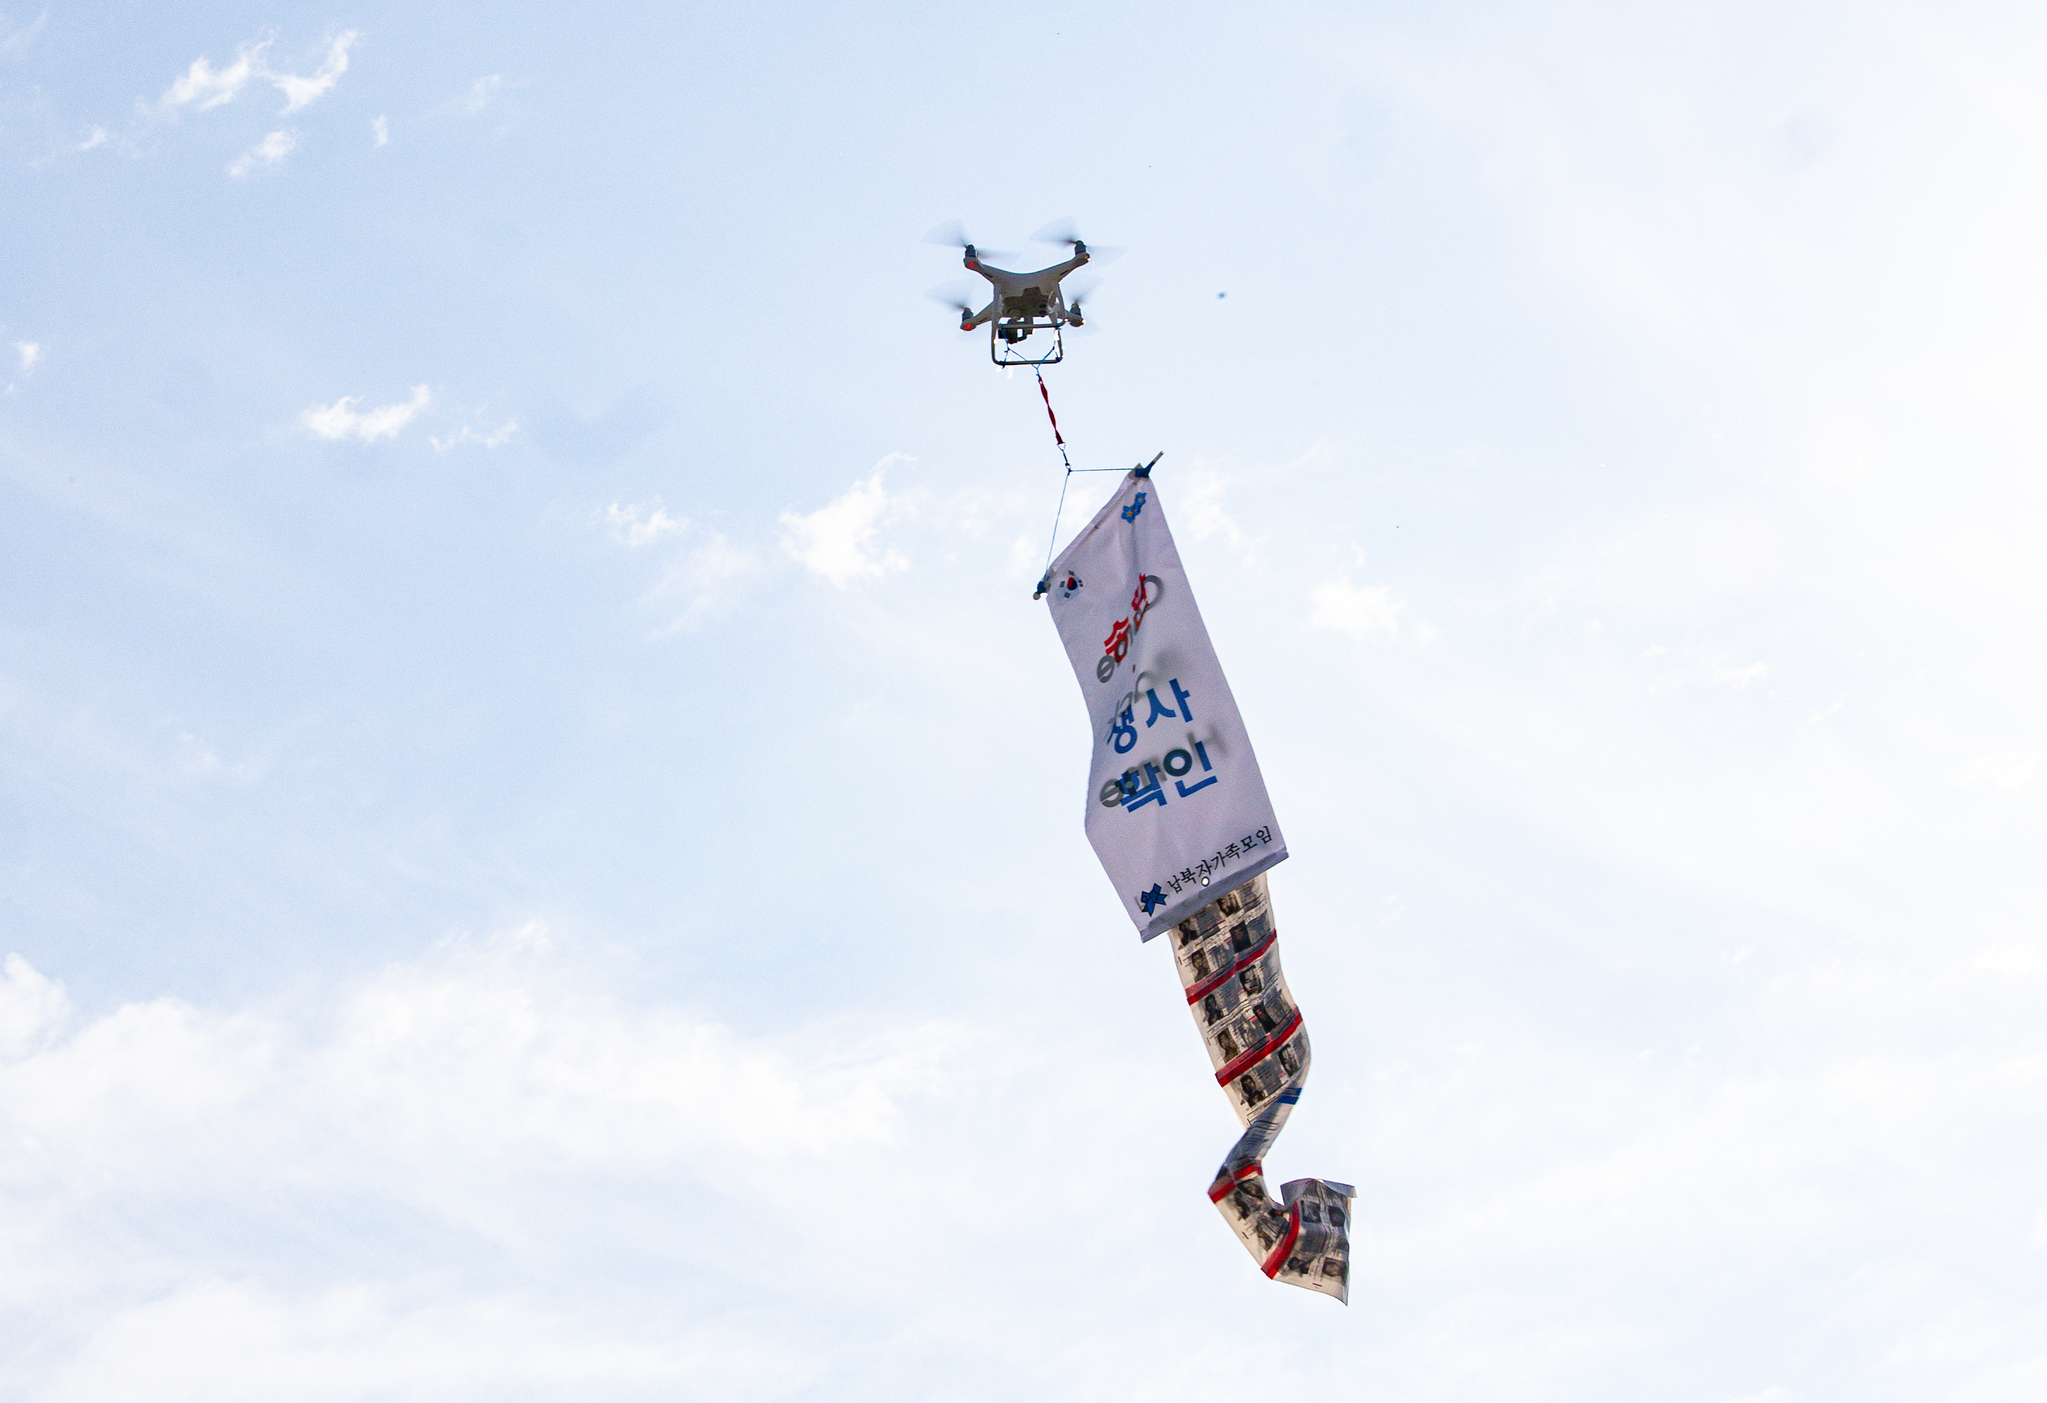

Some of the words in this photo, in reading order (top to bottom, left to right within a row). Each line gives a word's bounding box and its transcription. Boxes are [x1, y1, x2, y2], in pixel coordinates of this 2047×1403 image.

[1106, 677, 1194, 755] 생사
[1115, 741, 1218, 813] 확인
[1166, 825, 1273, 894] 납북자가족모임
